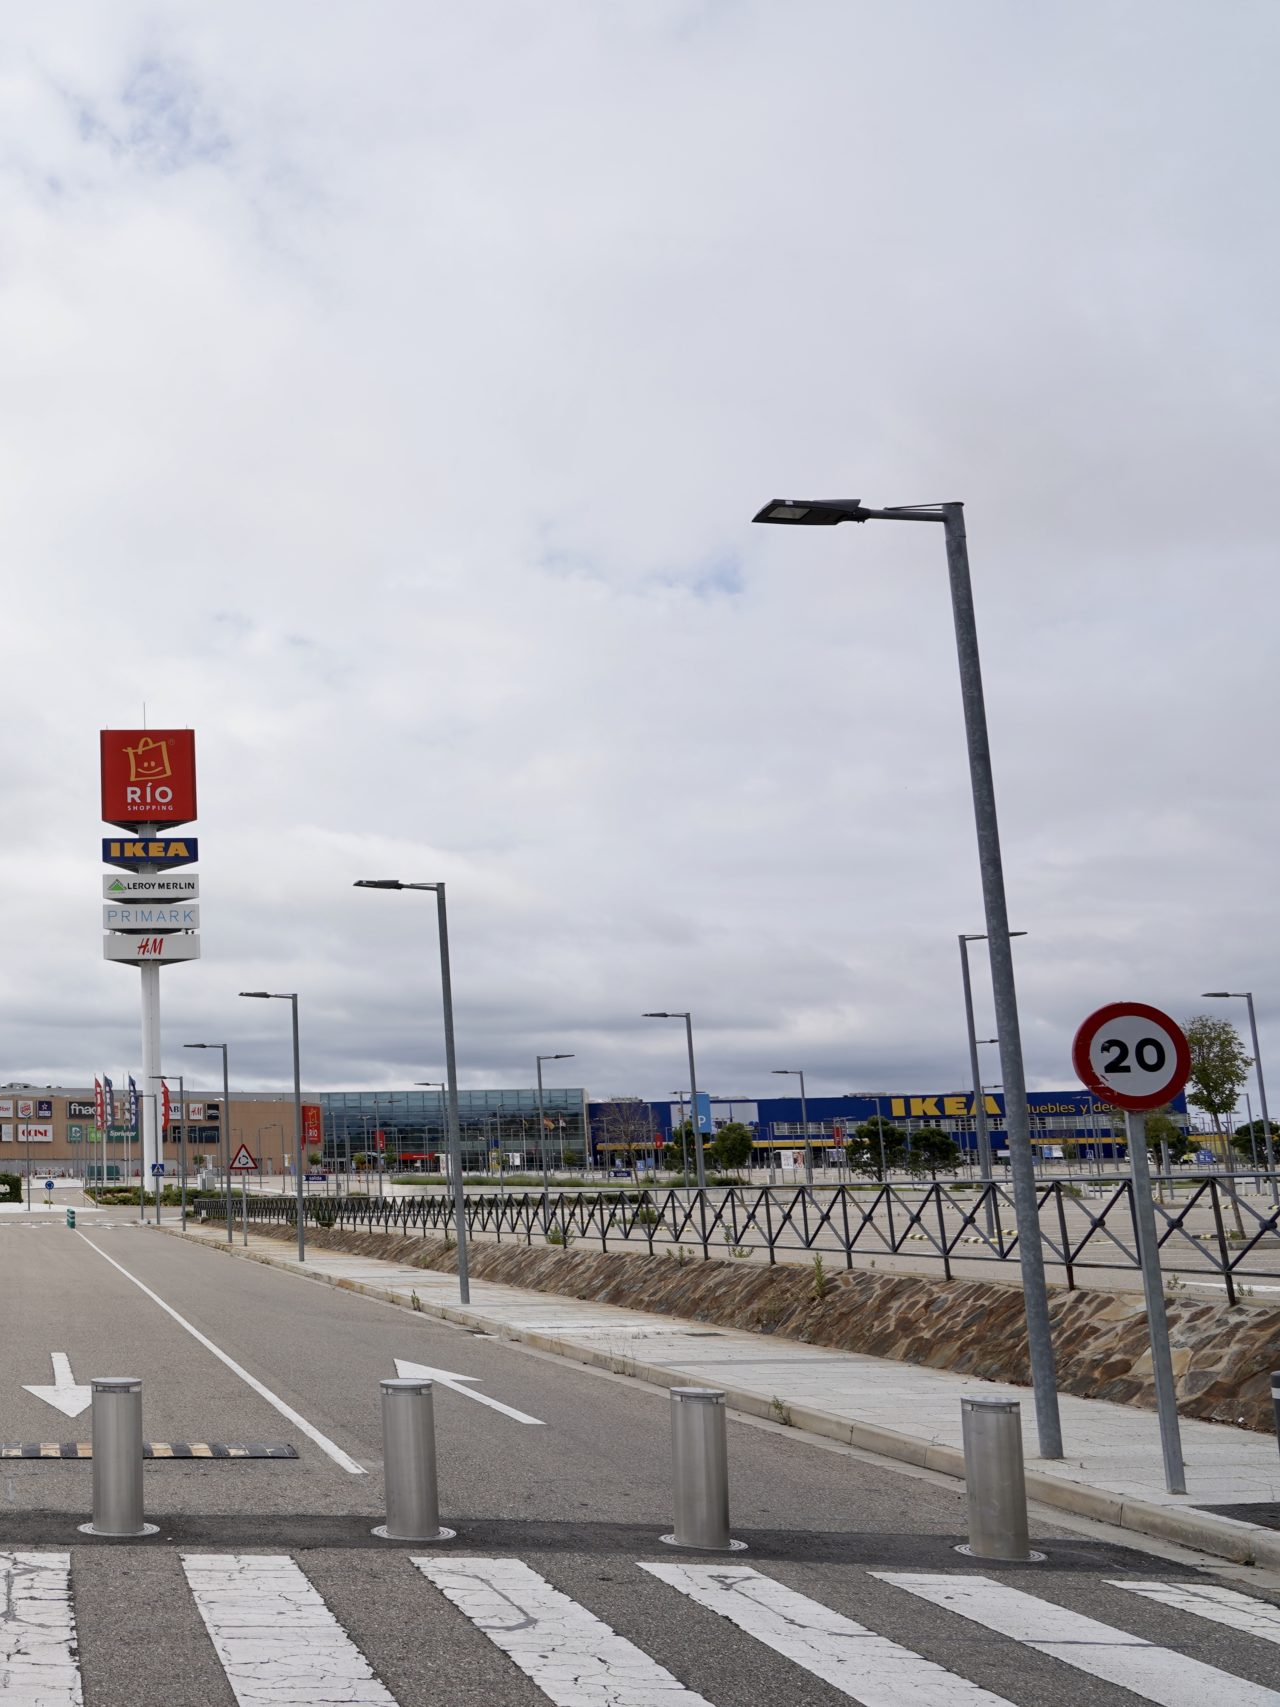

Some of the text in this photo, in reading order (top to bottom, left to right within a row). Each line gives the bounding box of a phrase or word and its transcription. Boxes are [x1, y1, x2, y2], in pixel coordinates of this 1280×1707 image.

[126, 782, 173, 803] RÍO
[110, 842, 190, 857] IKEA
[127, 882, 195, 890] LEROY MERLIN
[107, 910, 194, 922] PRIMARK
[137, 937, 164, 955] H&M
[1100, 1037, 1166, 1074] 20
[70, 1103, 97, 1115] fnac
[890, 1095, 1002, 1118] IKEA
[1080, 1104, 1088, 1114] y
